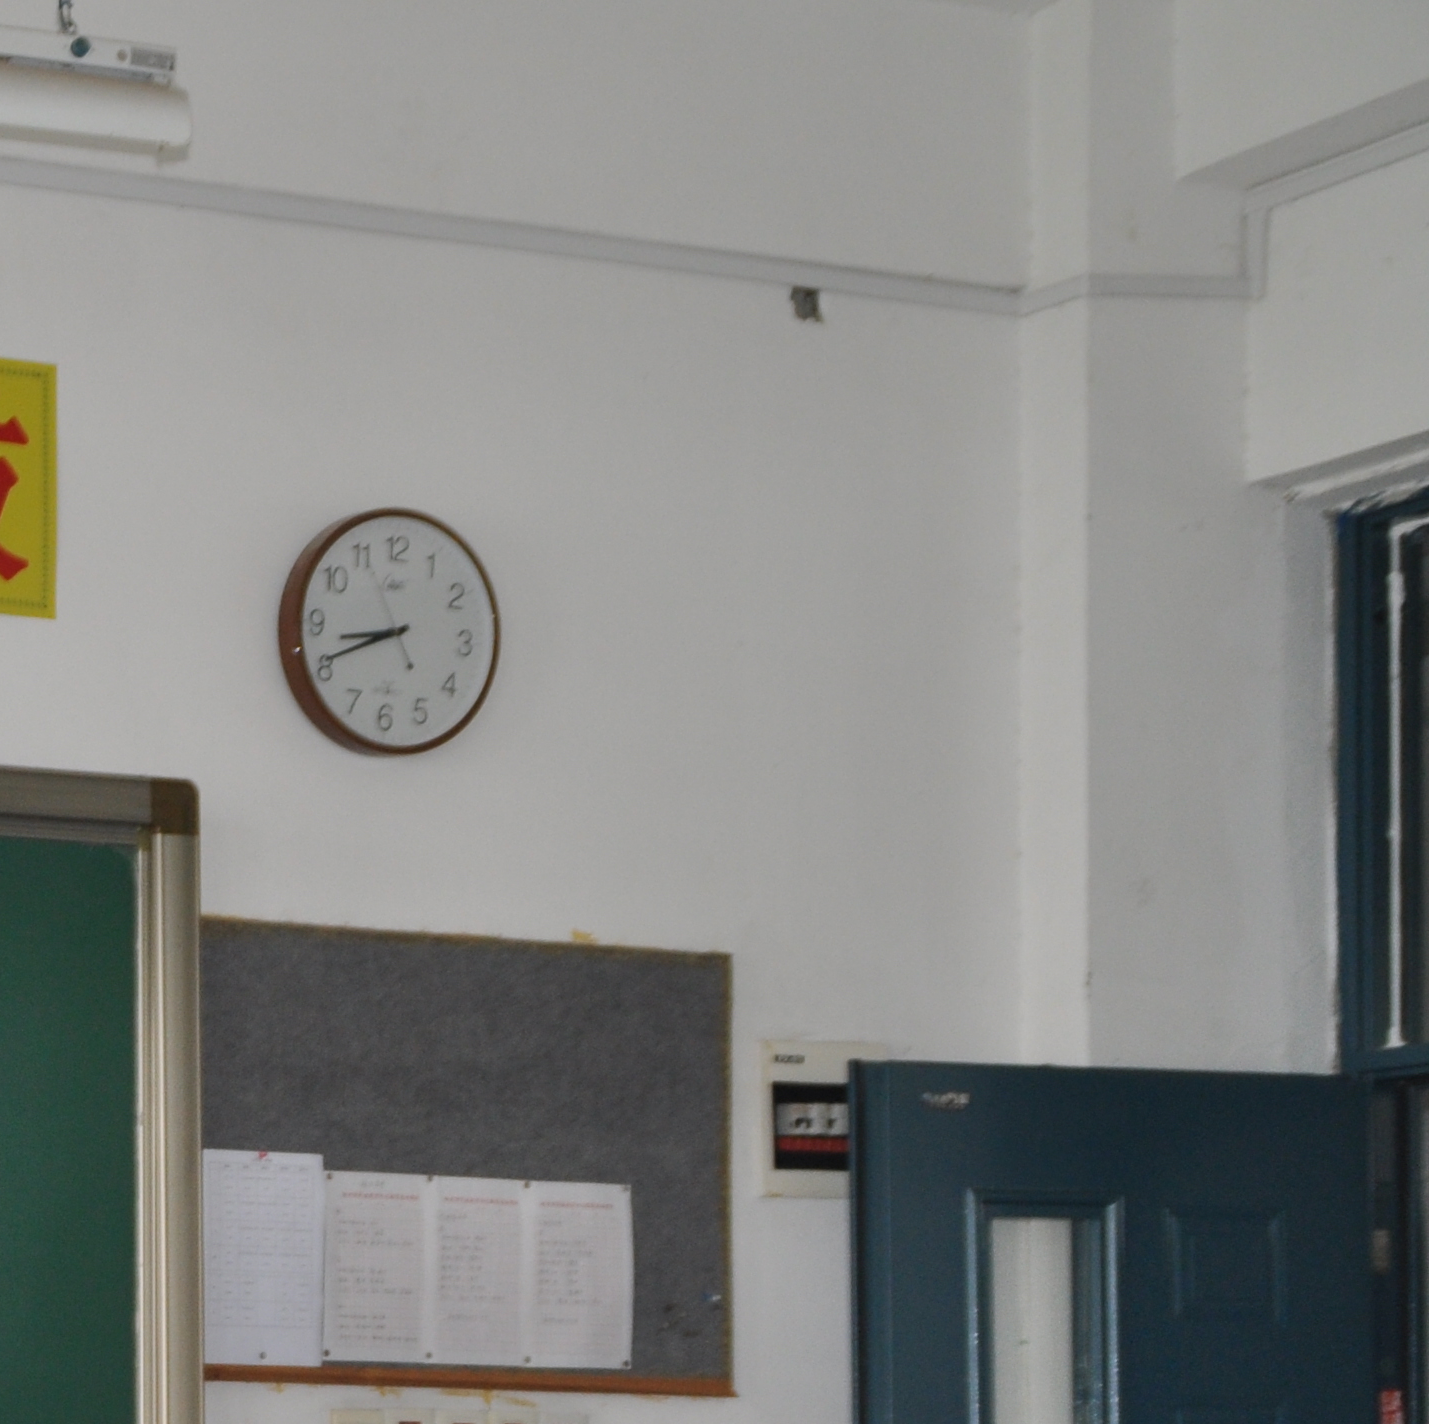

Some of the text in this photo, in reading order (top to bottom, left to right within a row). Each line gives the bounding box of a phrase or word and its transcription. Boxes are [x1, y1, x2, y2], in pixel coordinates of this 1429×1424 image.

[352, 543, 371, 569] 11
[385, 535, 410, 563] 12
[323, 564, 349, 593] 10
[427, 553, 436, 579] 1
[447, 582, 465, 610] 2
[309, 608, 325, 636] 9
[457, 629, 473, 657] 3
[317, 654, 333, 682] 8
[441, 672, 456, 697] 4
[347, 688, 363, 715] 7
[413, 697, 428, 724] 5
[377, 703, 393, 731] 6
